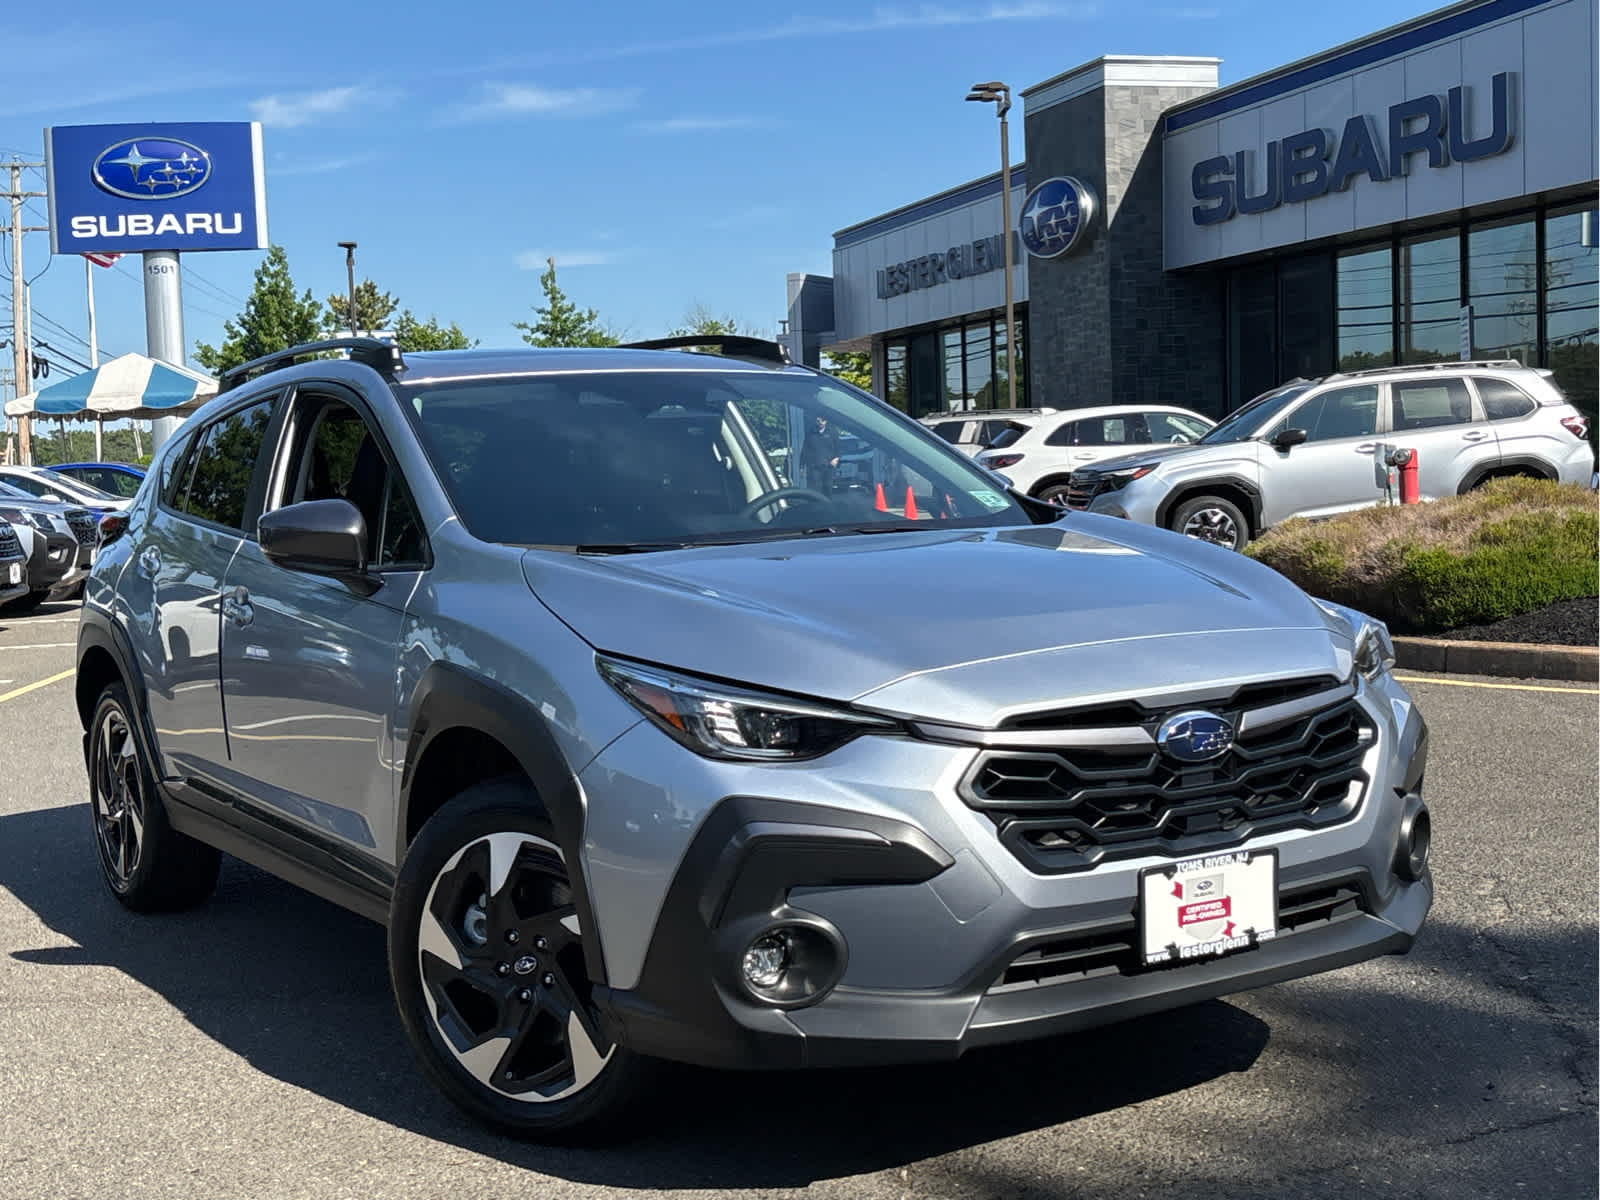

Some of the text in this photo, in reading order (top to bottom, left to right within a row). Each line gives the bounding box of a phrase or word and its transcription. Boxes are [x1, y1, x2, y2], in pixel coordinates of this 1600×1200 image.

[1192, 71, 1517, 226] SUBARU
[71, 212, 242, 238] SUBARU
[148, 264, 174, 275] 1501
[876, 252, 946, 299] LESTER
[1176, 858, 1203, 872] TOMS
[1235, 851, 1249, 864] NJ
[1179, 934, 1249, 959] lesterglenn
